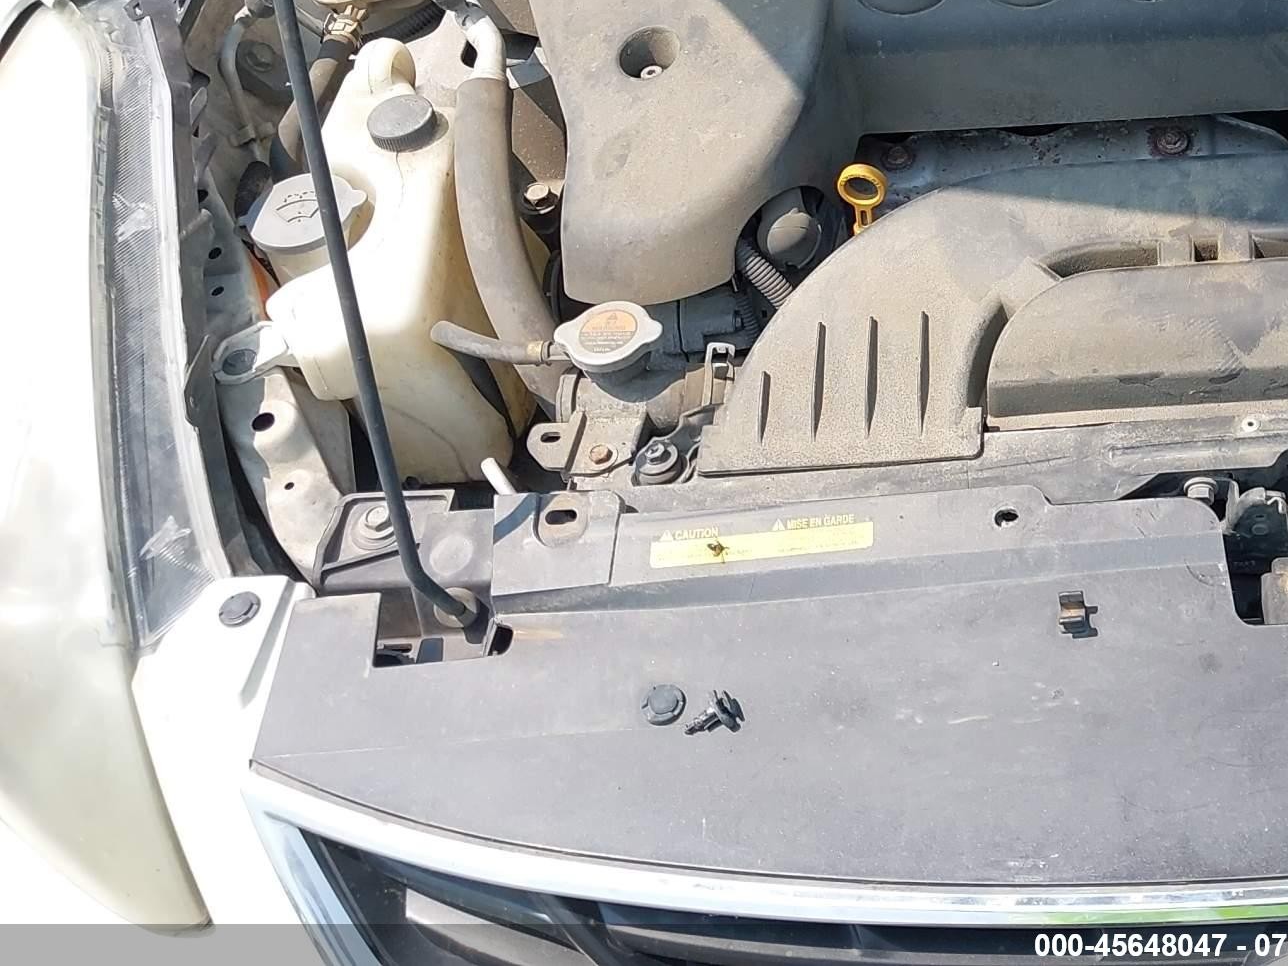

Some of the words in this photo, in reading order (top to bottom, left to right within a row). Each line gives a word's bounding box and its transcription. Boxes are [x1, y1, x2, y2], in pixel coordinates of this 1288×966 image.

[786, 518, 809, 530] MISE
[809, 517, 822, 528] EN
[823, 514, 855, 526] GARDE
[675, 524, 719, 540] CAUTION
